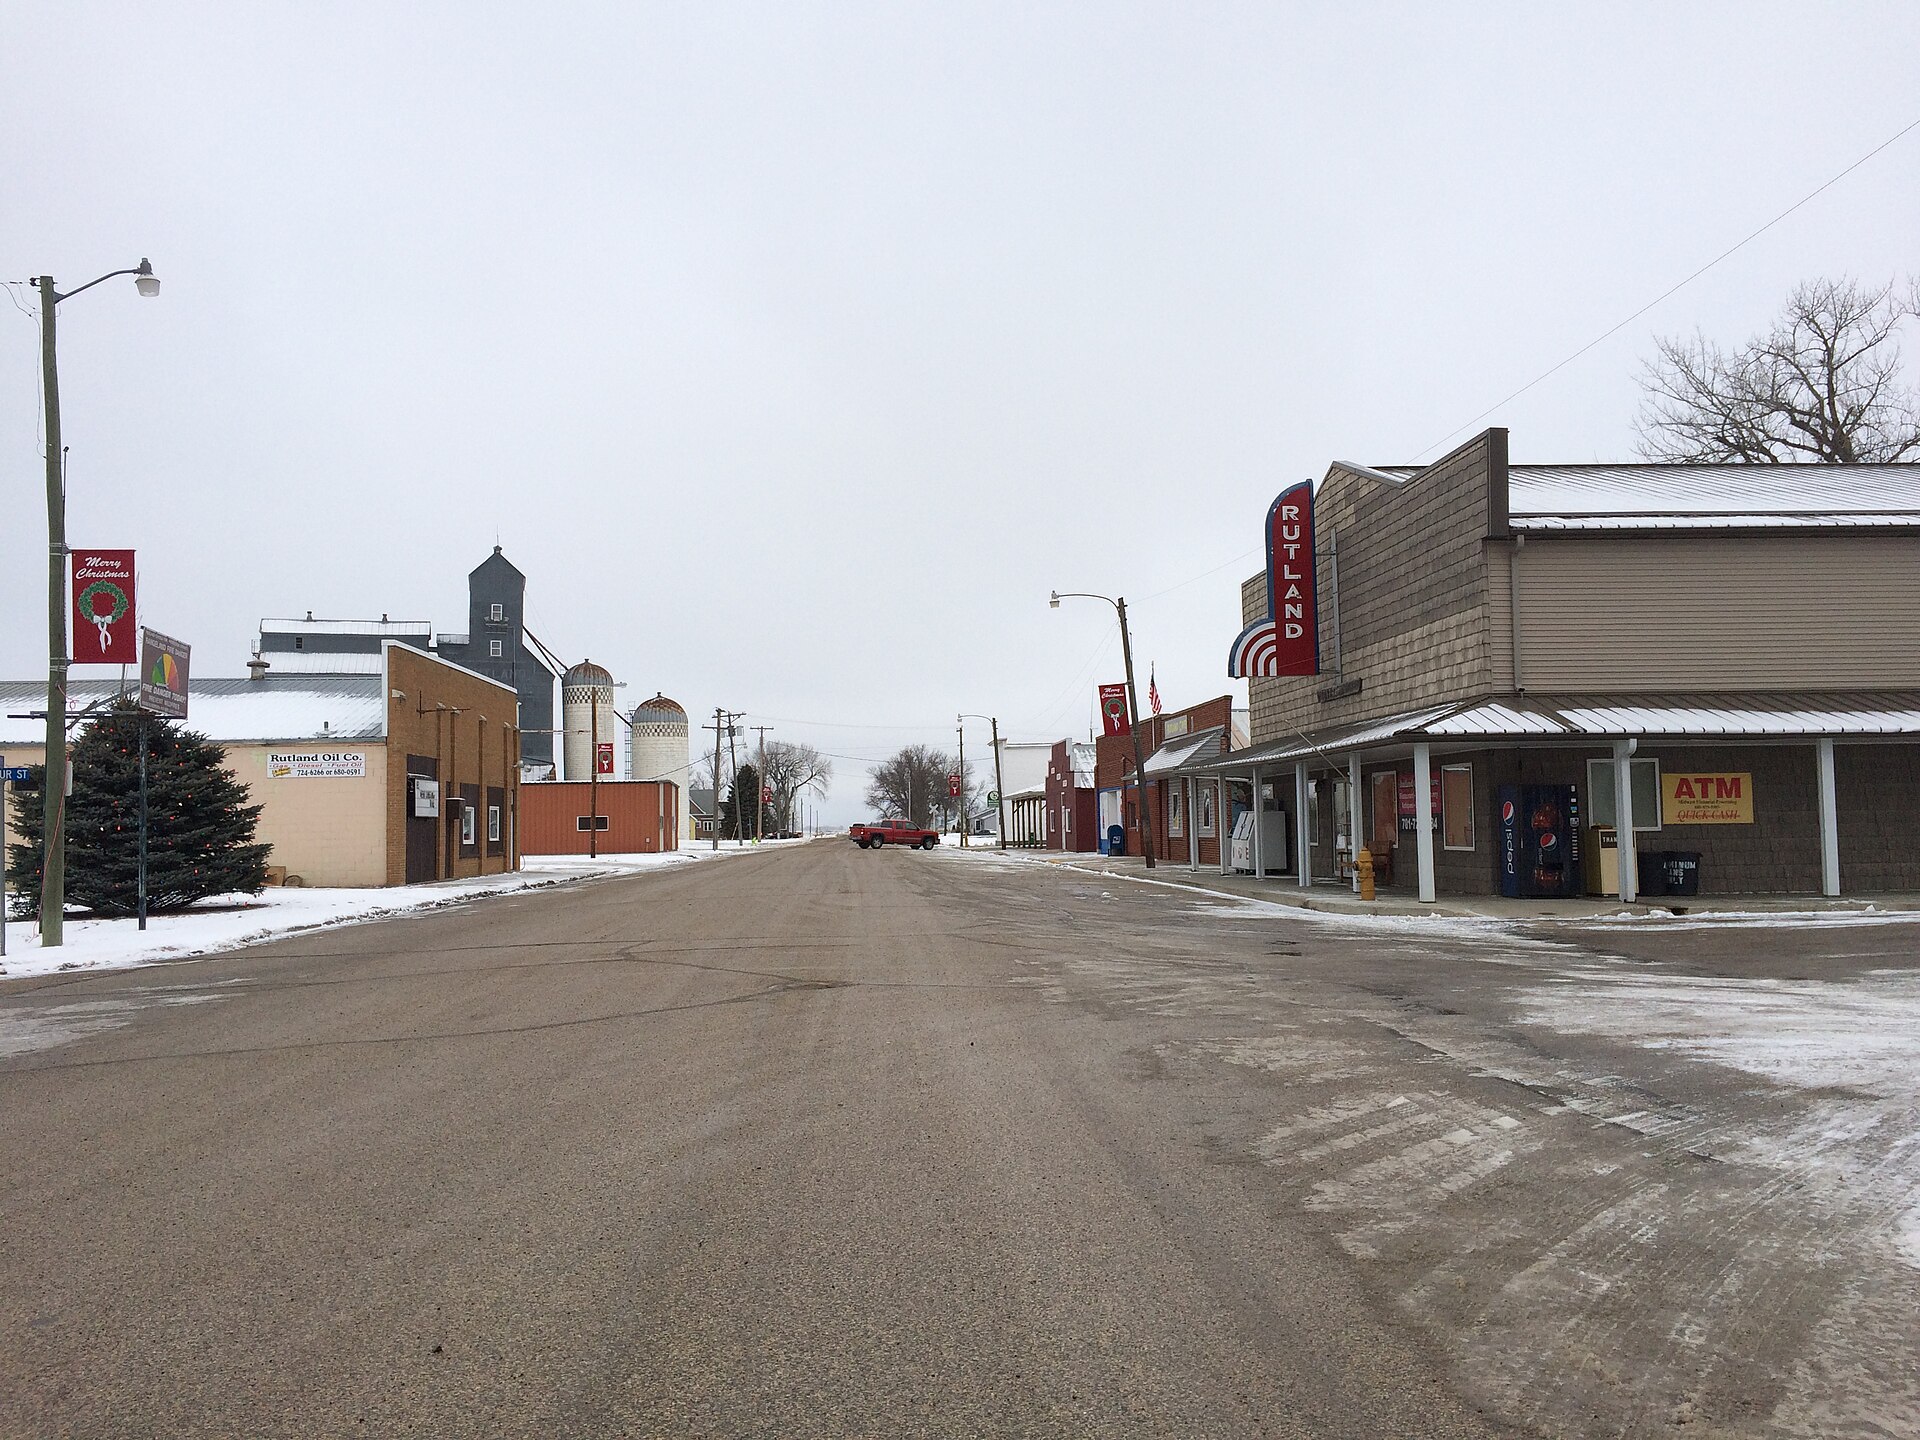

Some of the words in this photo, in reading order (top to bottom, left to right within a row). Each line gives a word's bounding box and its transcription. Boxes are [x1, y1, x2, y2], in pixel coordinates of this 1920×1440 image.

[85, 556, 122, 569] Merry
[75, 567, 130, 580] Christmas
[1281, 505, 1303, 639] RUTLAND
[142, 683, 153, 693] FIRE
[153, 686, 172, 699] DANGER
[271, 754, 318, 762] Rutland
[322, 753, 340, 762] Oil
[343, 753, 362, 761] Co.
[16, 769, 28, 779] ST
[333, 768, 361, 776] 680-0591
[1674, 777, 1742, 799] ATM
[1677, 810, 1710, 822] QUICK
[1711, 810, 1740, 820] CASH
[1505, 828, 1514, 874] pepsi
